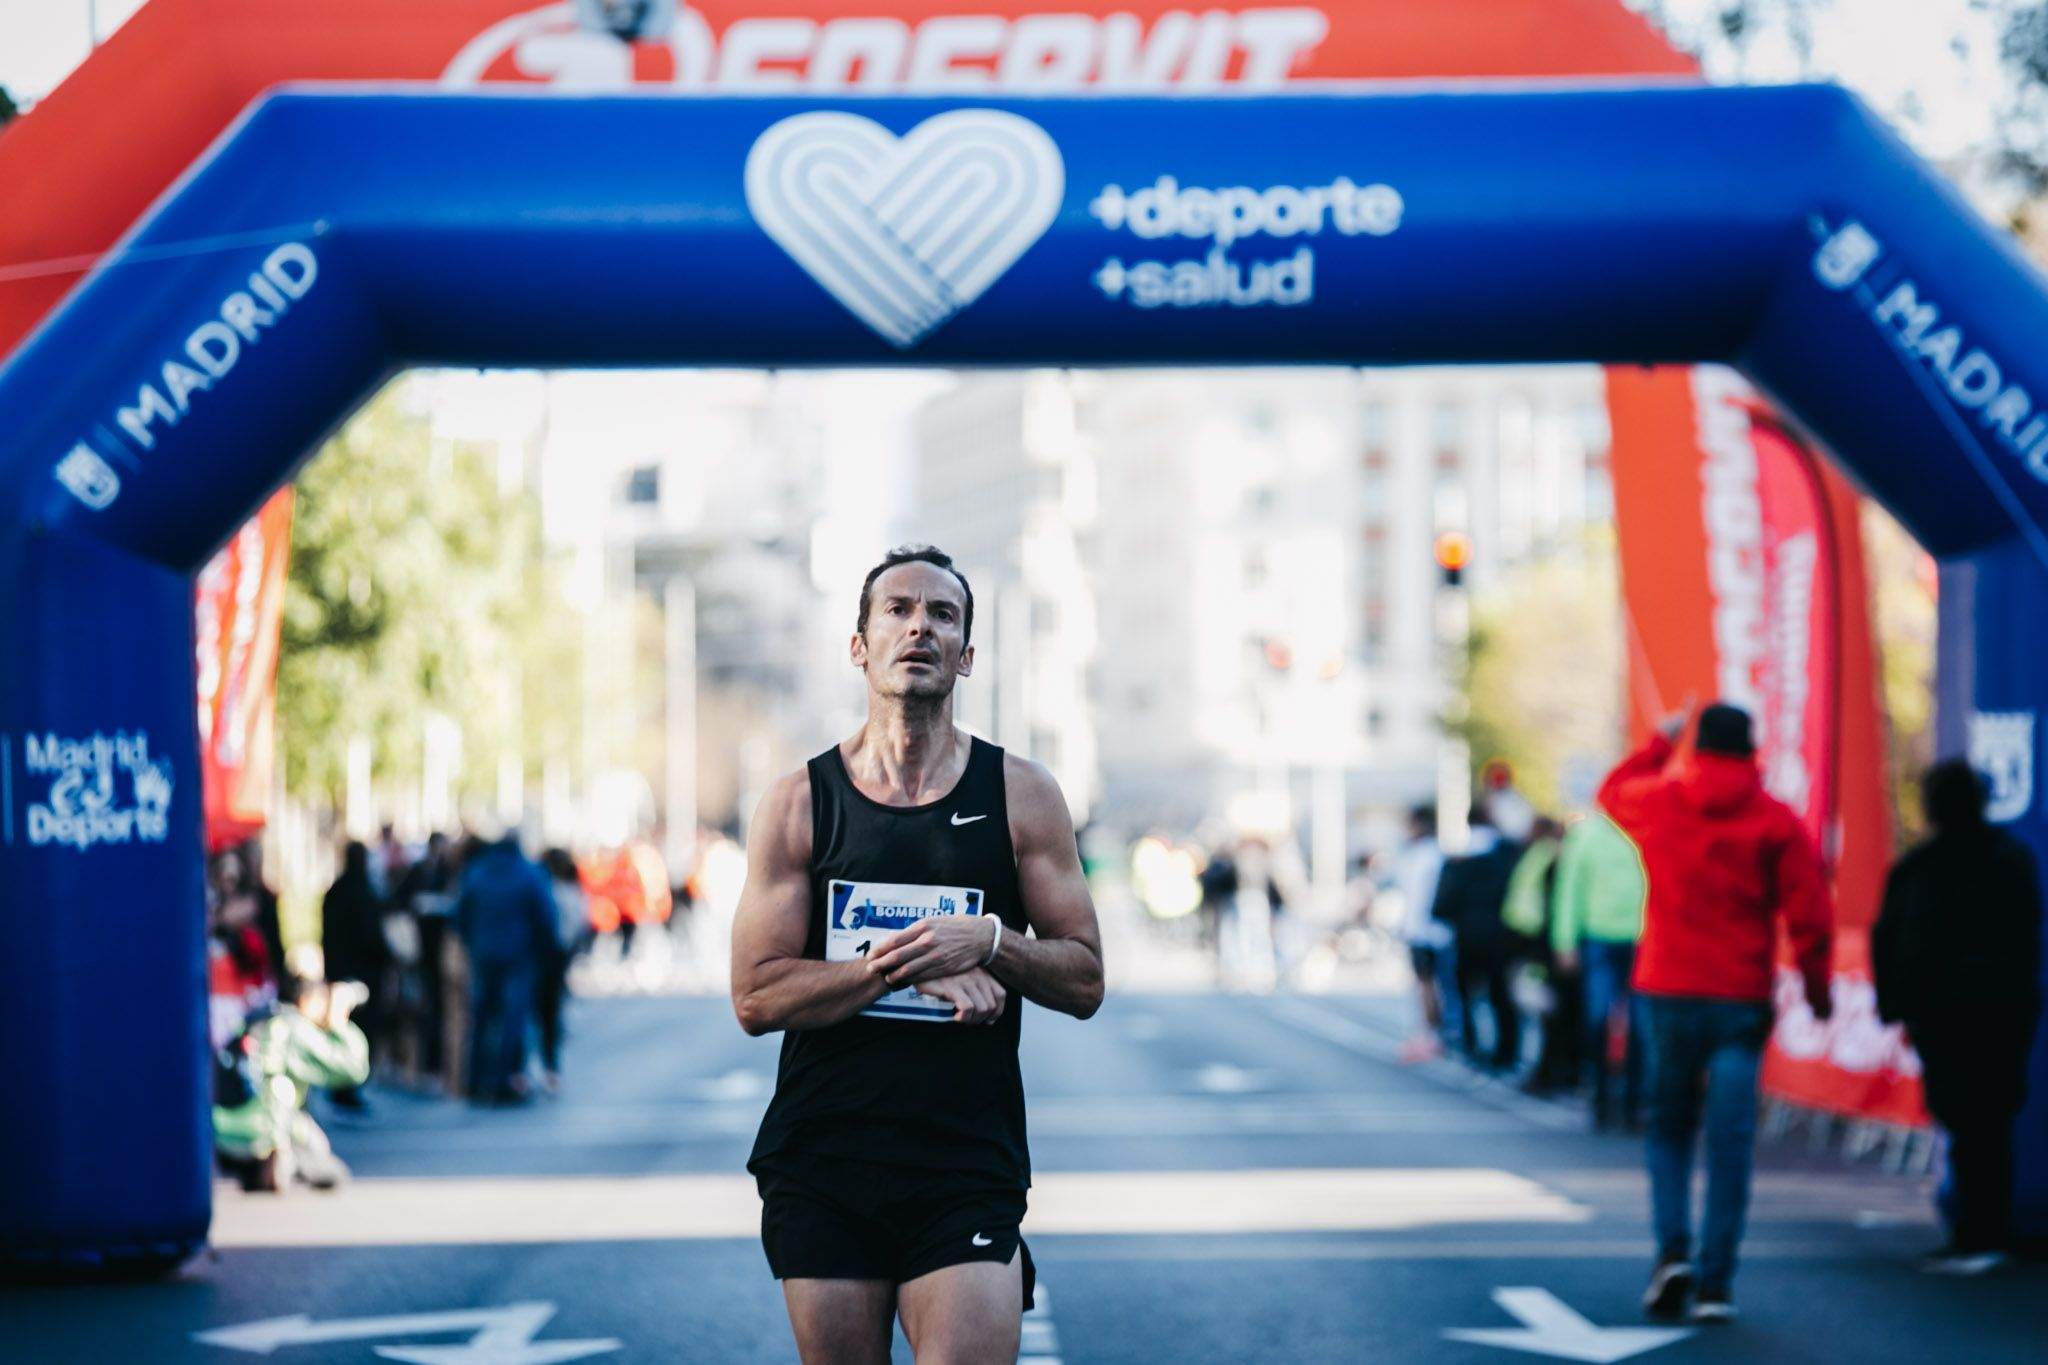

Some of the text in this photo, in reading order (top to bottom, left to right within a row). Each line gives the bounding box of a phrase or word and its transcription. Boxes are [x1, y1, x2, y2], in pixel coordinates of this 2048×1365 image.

[115, 241, 318, 449] MADRID
[25, 730, 148, 772] Madrid
[28, 804, 168, 850] Deporte
